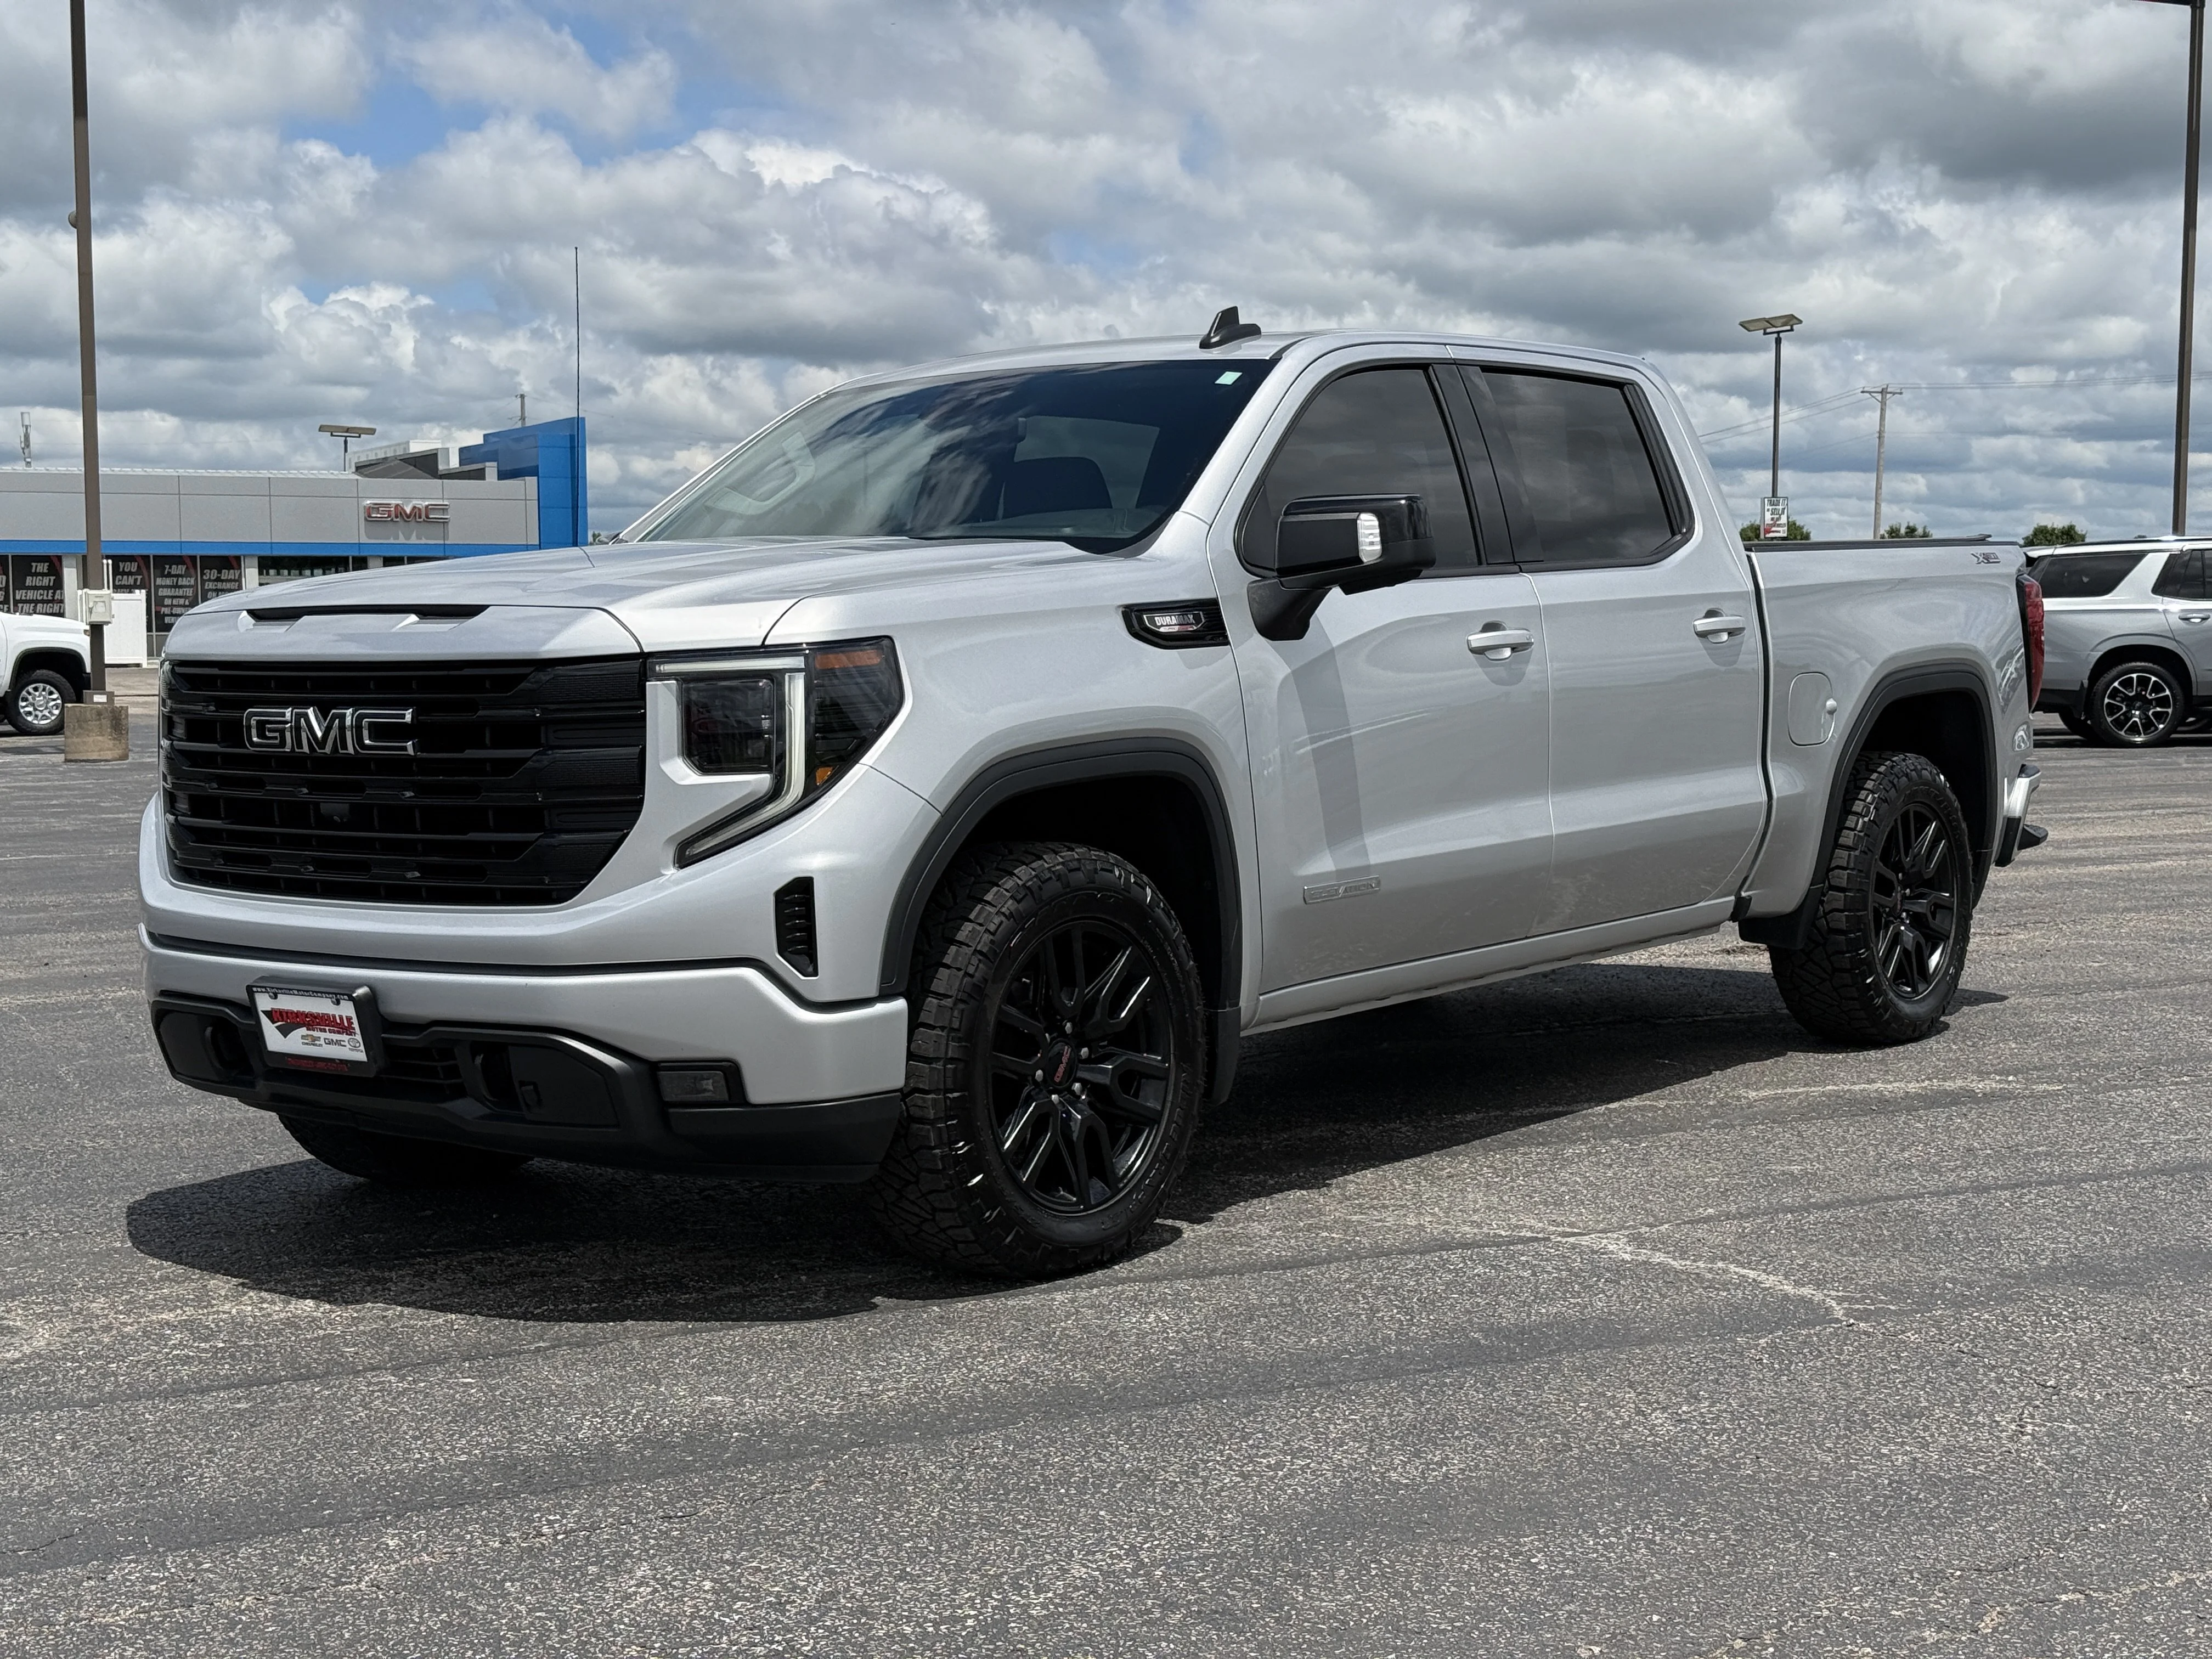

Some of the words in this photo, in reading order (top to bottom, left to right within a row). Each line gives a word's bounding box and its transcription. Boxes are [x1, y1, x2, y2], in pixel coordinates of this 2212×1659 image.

[364, 500, 450, 522] GMC
[31, 562, 49, 573] THE
[119, 561, 138, 572] YOU
[165, 565, 187, 575] 7-DAY
[115, 575, 143, 585] CAN'T
[203, 569, 240, 580] 30-DAY
[25, 575, 55, 586] RIGHT
[156, 577, 178, 586] MONEY
[178, 577, 195, 586] BACK
[15, 590, 53, 600] VEHICLE
[159, 588, 193, 596] GUARANTEE
[18, 603, 35, 614] THE
[36, 603, 64, 614] RIGHT
[1154, 614, 1195, 626] DURAMAX
[244, 707, 415, 755] GMC
[271, 1008, 356, 1031] KIRKSVILLE
[324, 1037, 347, 1047] GMC
